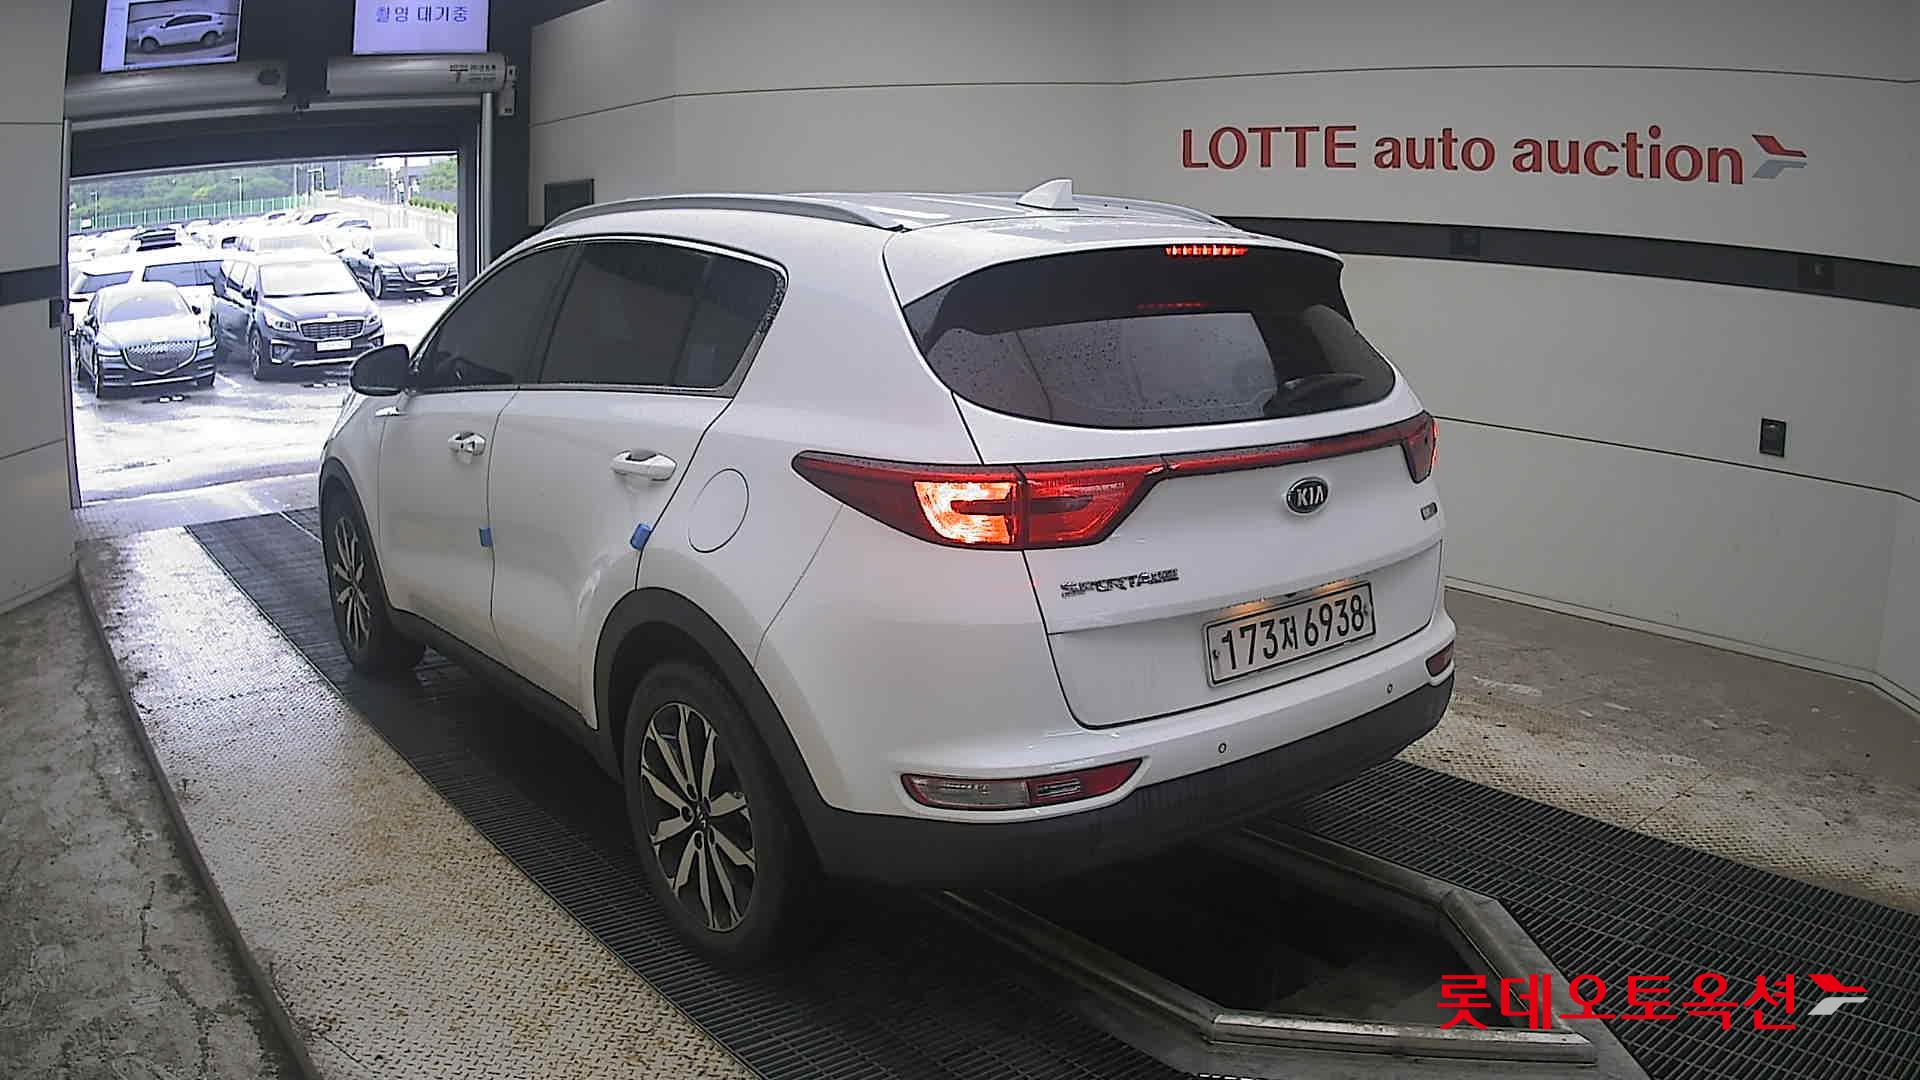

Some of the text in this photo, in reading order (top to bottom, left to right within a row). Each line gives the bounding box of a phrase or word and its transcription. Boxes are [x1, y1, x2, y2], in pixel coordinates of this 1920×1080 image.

[416, 5, 468, 23] 대기중
[1183, 125, 1744, 184] LOTTE auto auction
[1296, 485, 1324, 506] KIA
